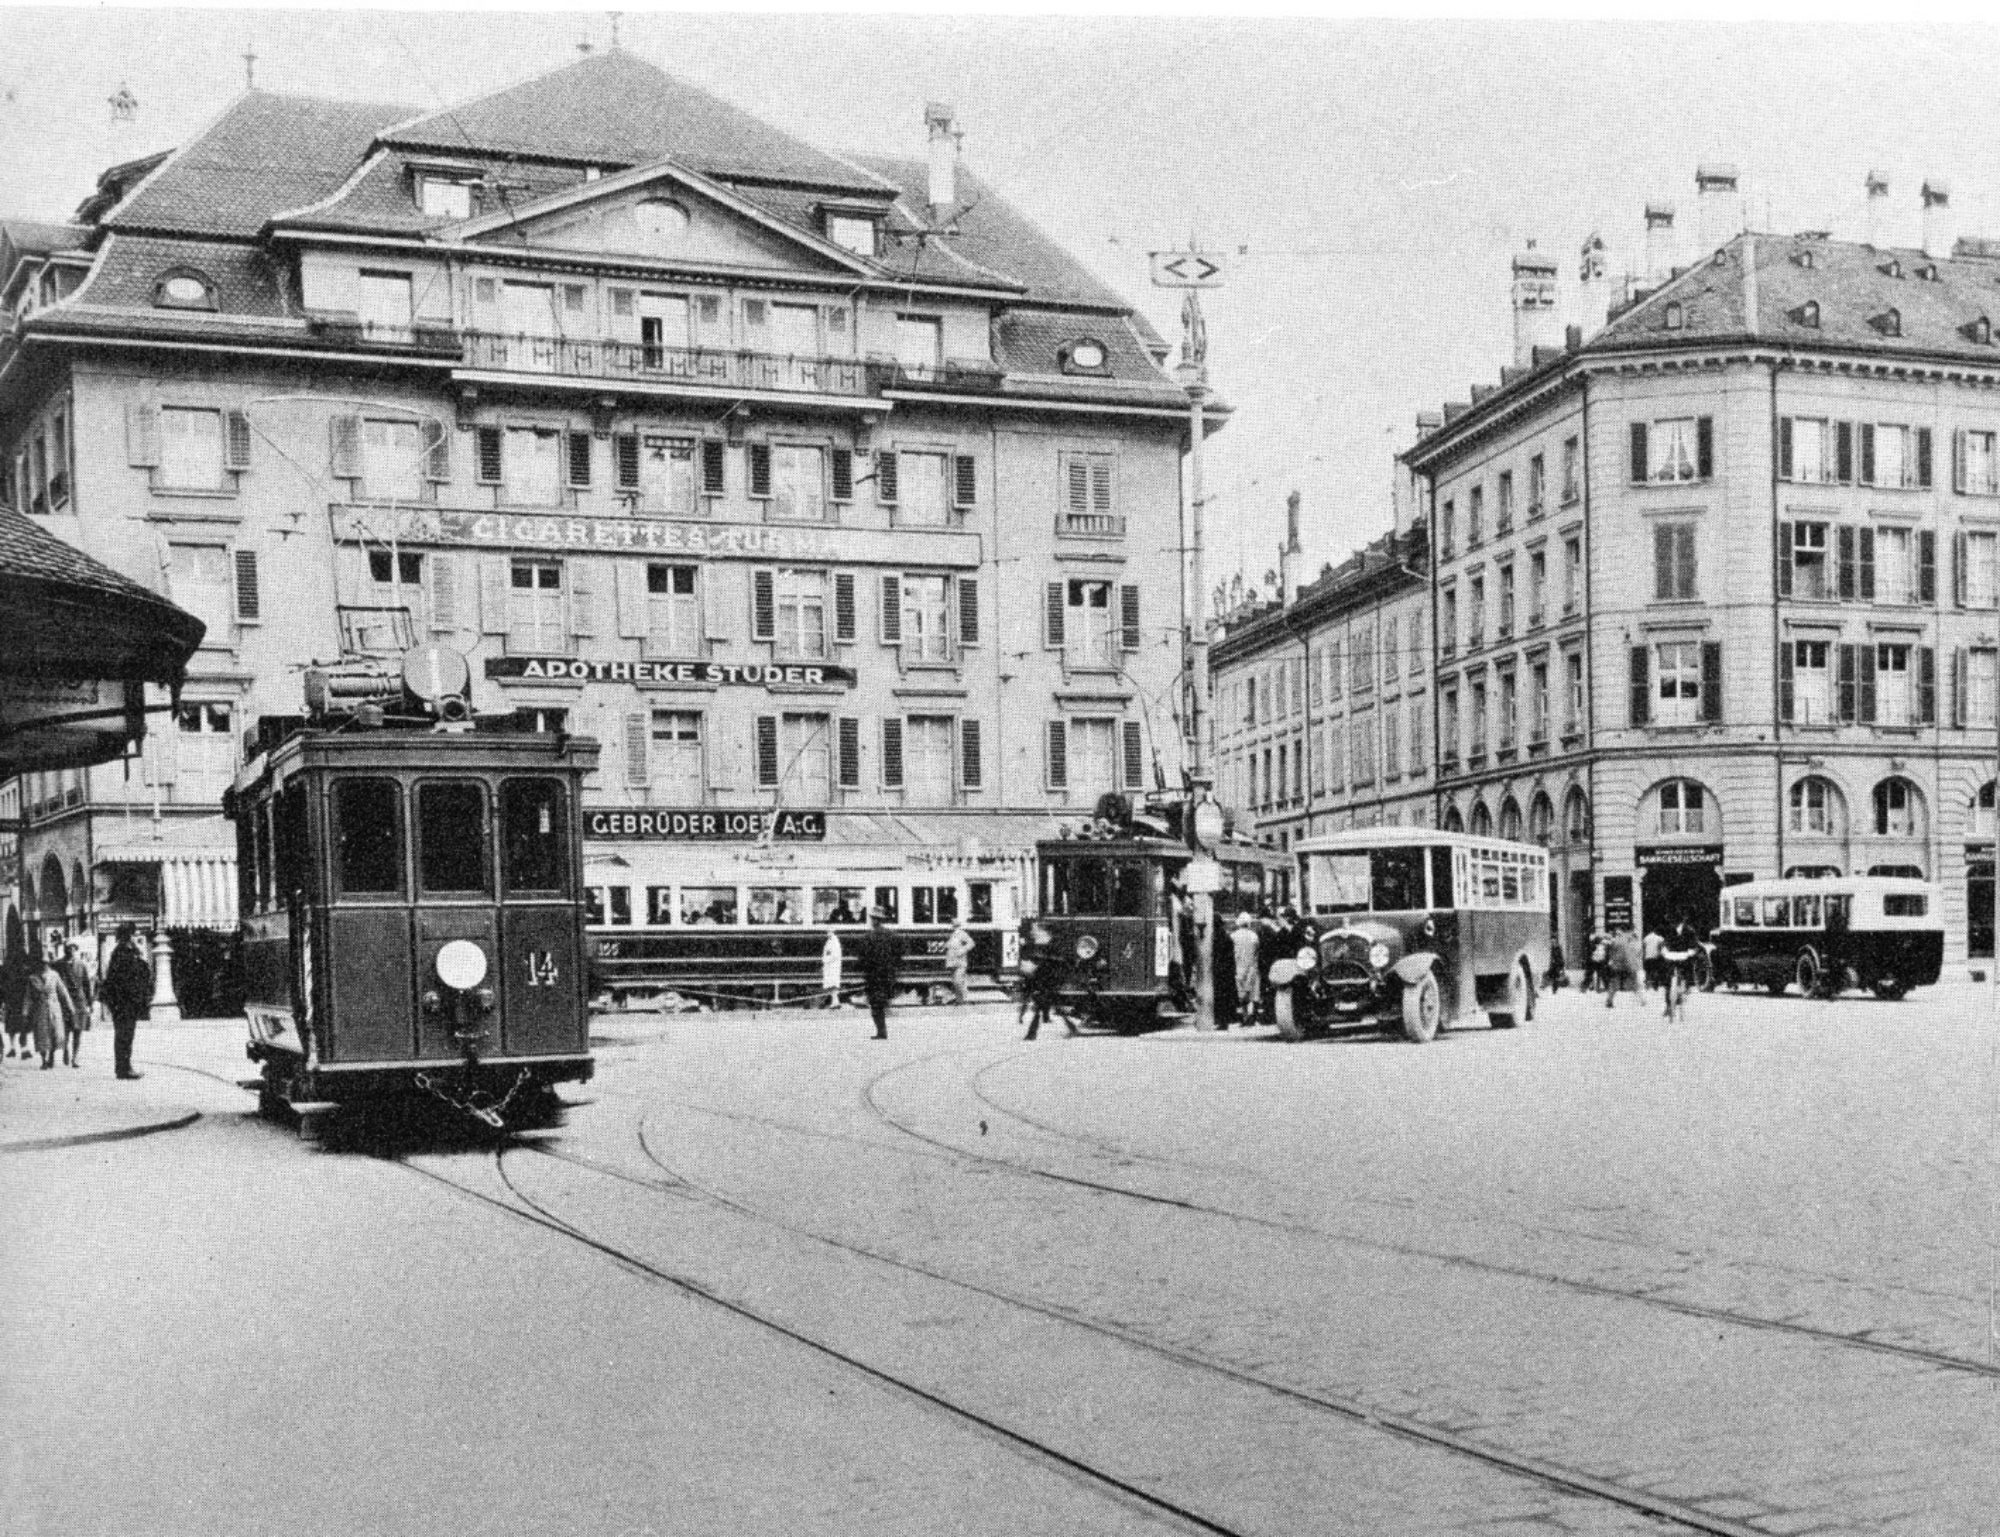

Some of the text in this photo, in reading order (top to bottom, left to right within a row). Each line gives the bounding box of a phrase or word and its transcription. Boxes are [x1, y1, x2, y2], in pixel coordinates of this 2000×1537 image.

[473, 516, 707, 551] CIGARETTES
[523, 660, 825, 685] APOTHEKE STUDER
[591, 811, 716, 834] GEBRÜDER
[522, 951, 559, 987] 14
